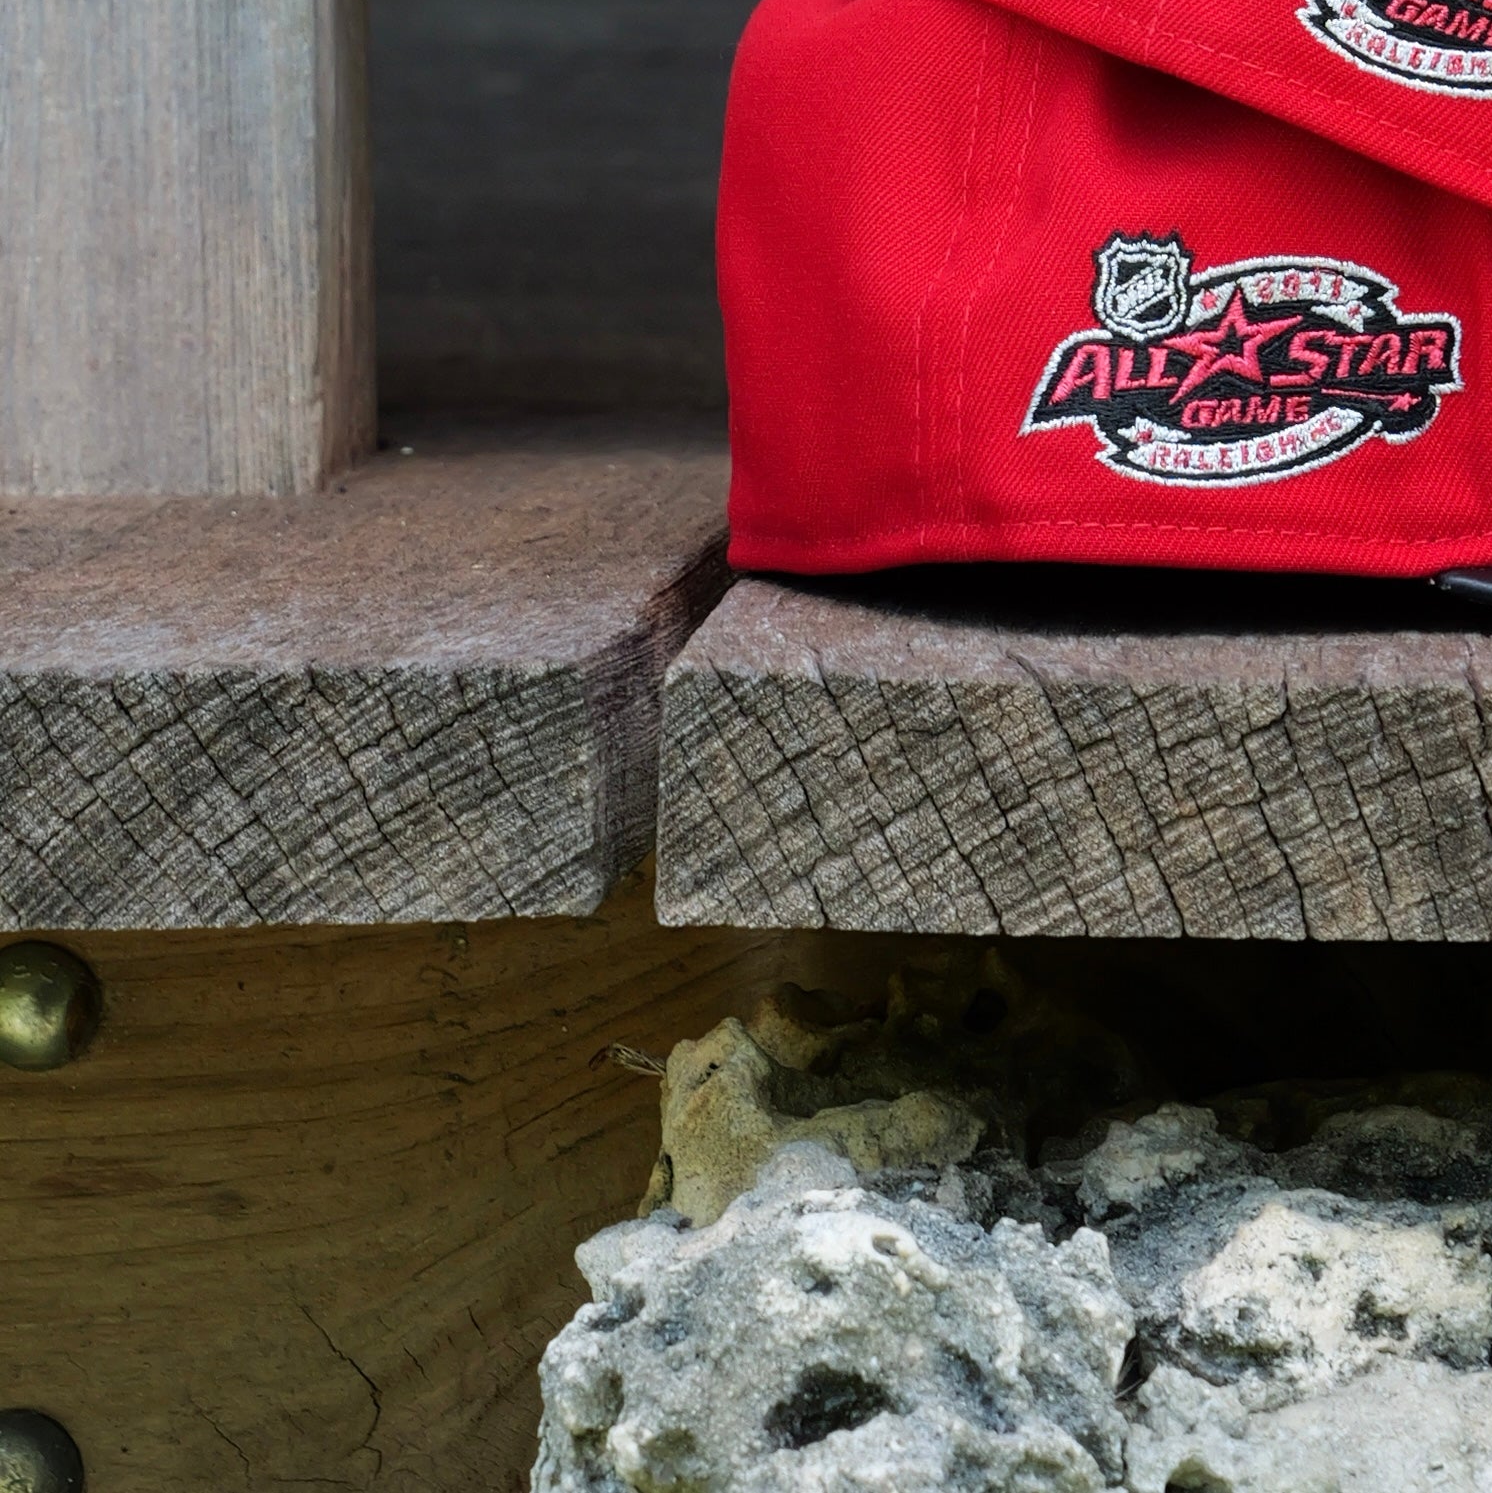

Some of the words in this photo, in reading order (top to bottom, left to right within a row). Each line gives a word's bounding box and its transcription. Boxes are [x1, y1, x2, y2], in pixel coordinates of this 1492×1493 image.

[1254, 269, 1343, 301] 2011
[1048, 343, 1179, 406] ALL
[1268, 329, 1449, 389] STAR
[1180, 394, 1314, 429] GAME
